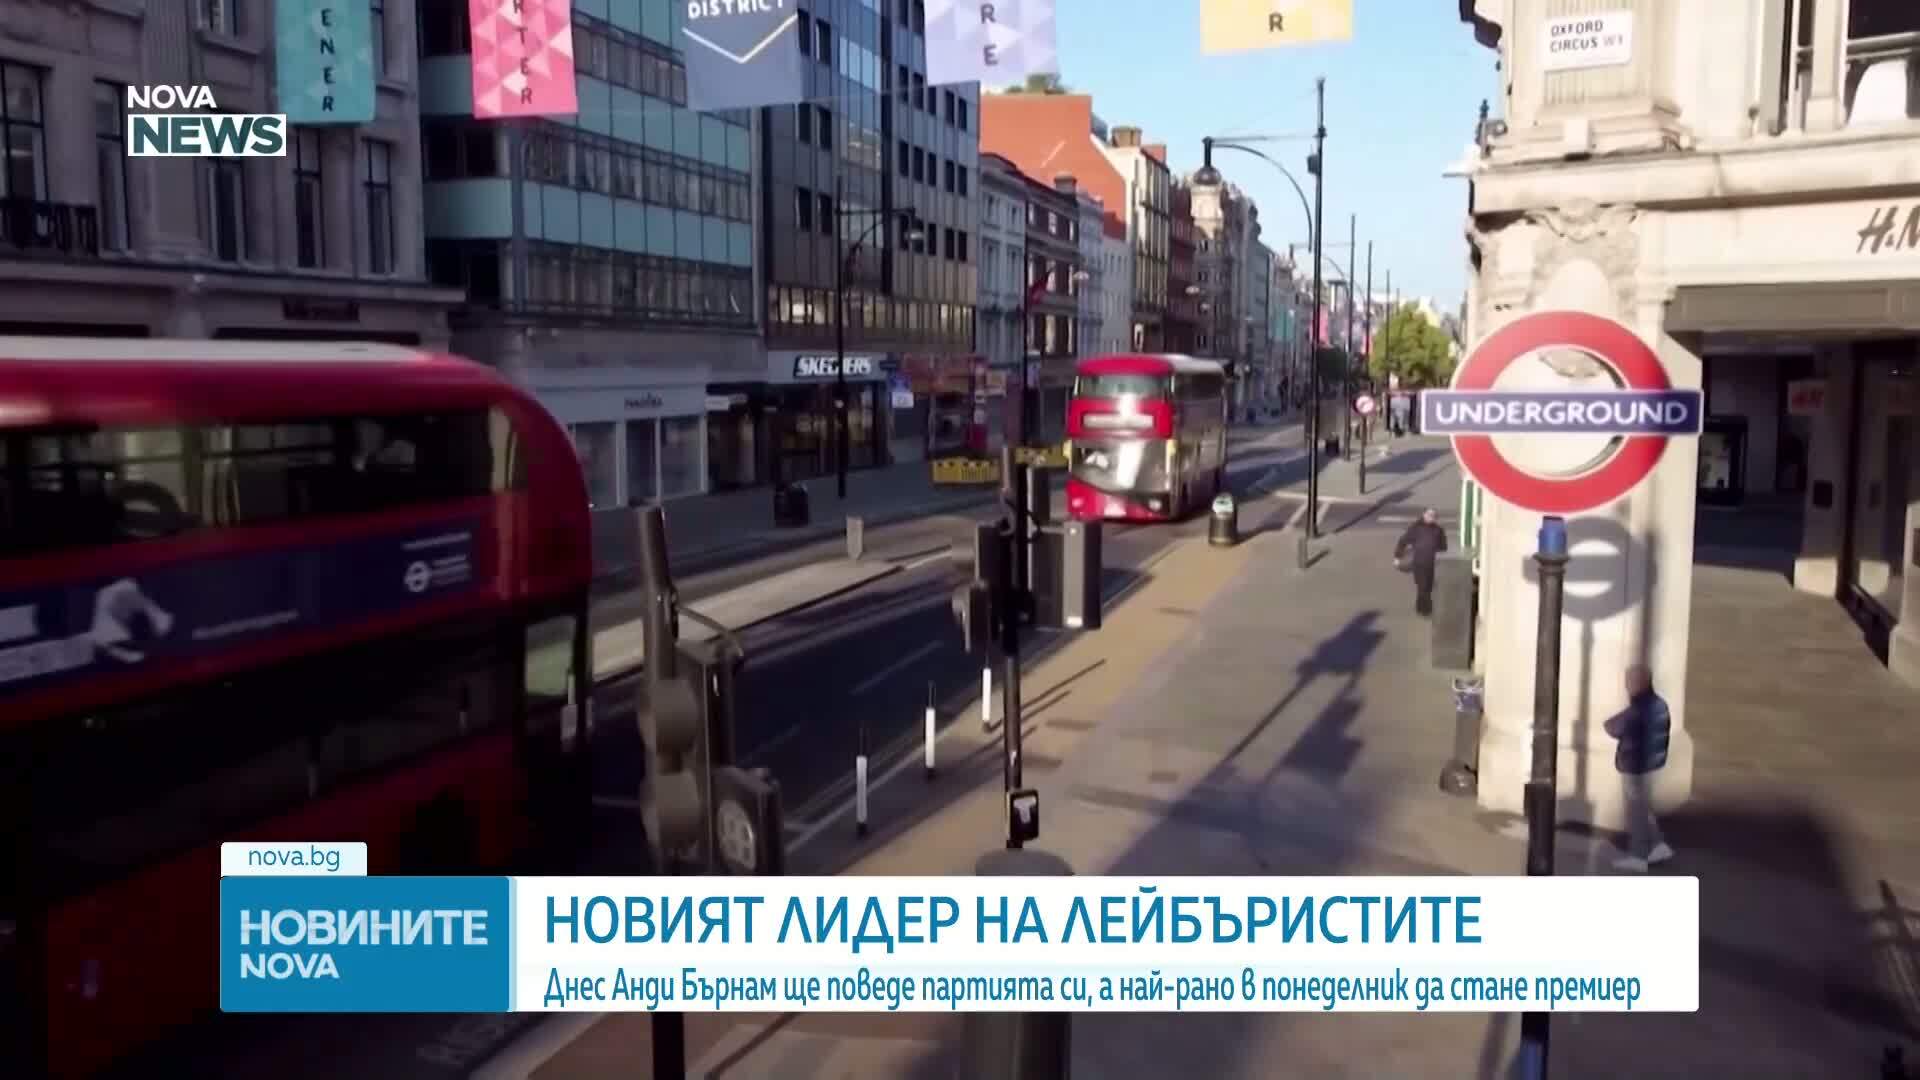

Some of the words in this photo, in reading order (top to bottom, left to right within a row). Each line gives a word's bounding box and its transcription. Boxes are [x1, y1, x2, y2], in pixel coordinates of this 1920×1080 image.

[1551, 19, 1604, 37] OXFORD
[1549, 36, 1599, 54] CIRCUS
[1435, 400, 1688, 425] UNDERGROUND
